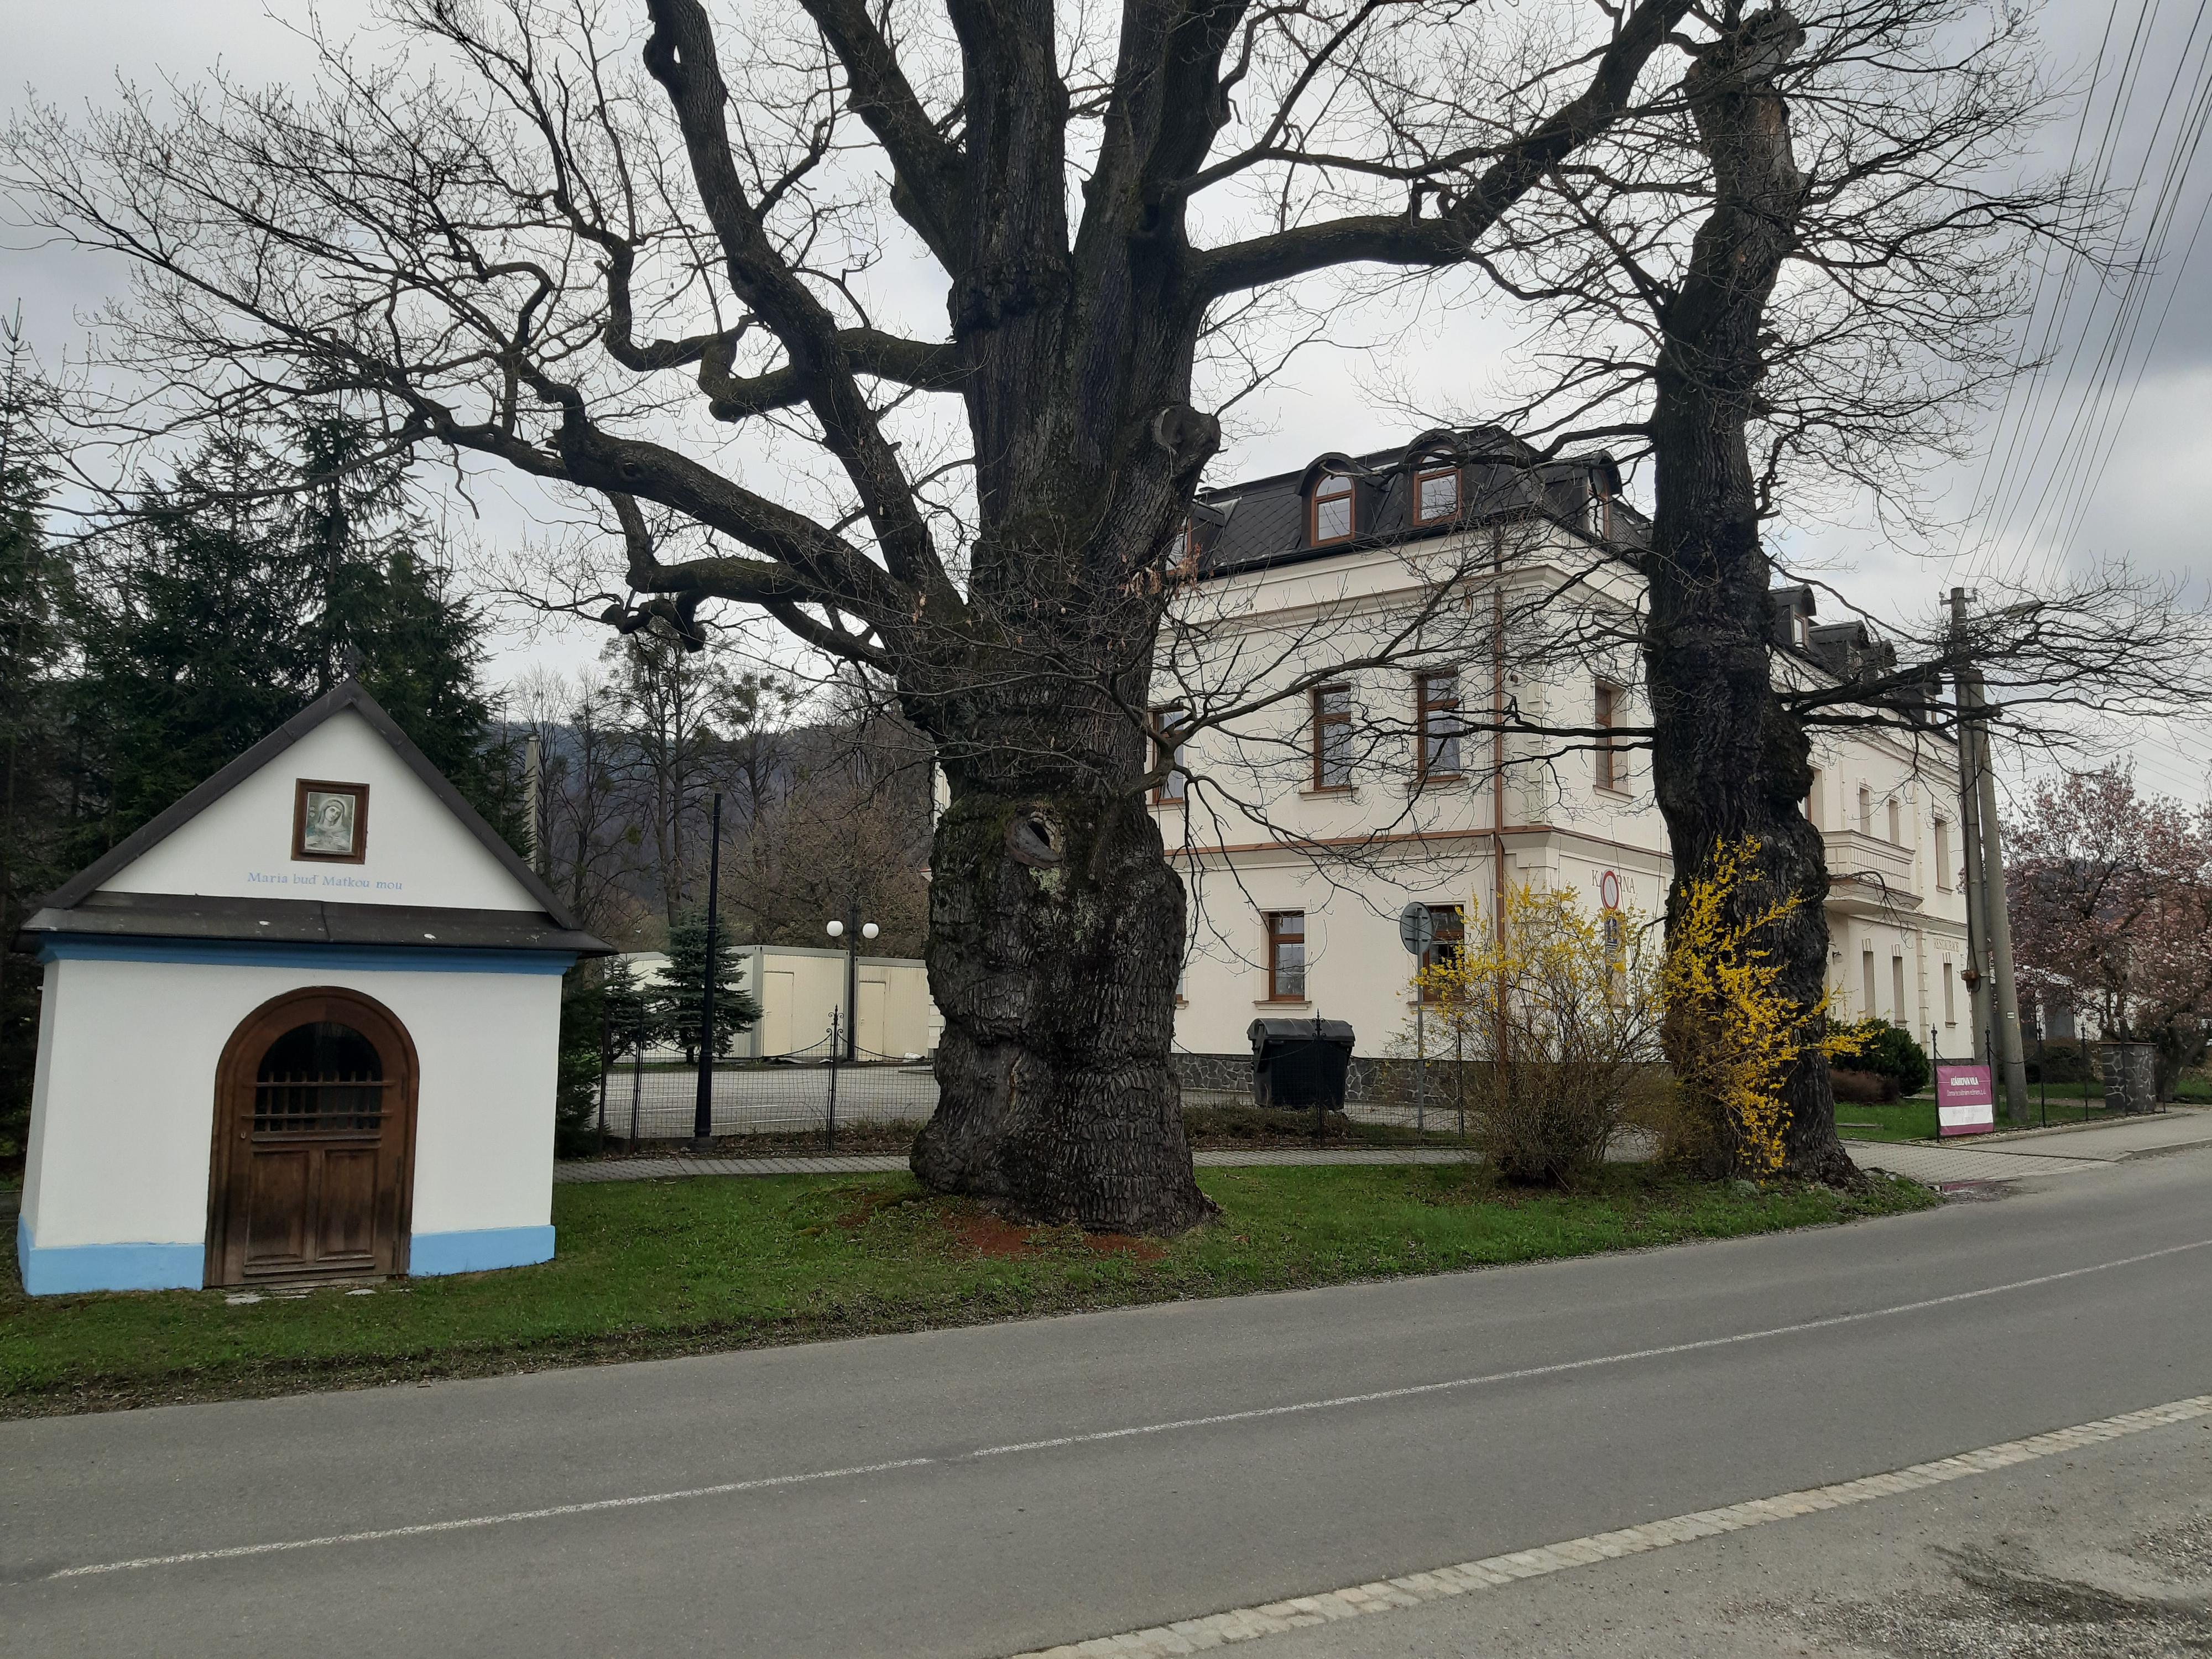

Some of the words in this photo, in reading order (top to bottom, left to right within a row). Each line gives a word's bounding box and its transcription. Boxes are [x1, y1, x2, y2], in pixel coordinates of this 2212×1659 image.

[247, 872, 288, 883] Maria
[322, 876, 369, 888] Matkou
[376, 881, 402, 890] mou
[1592, 869, 1636, 894] KARNA
